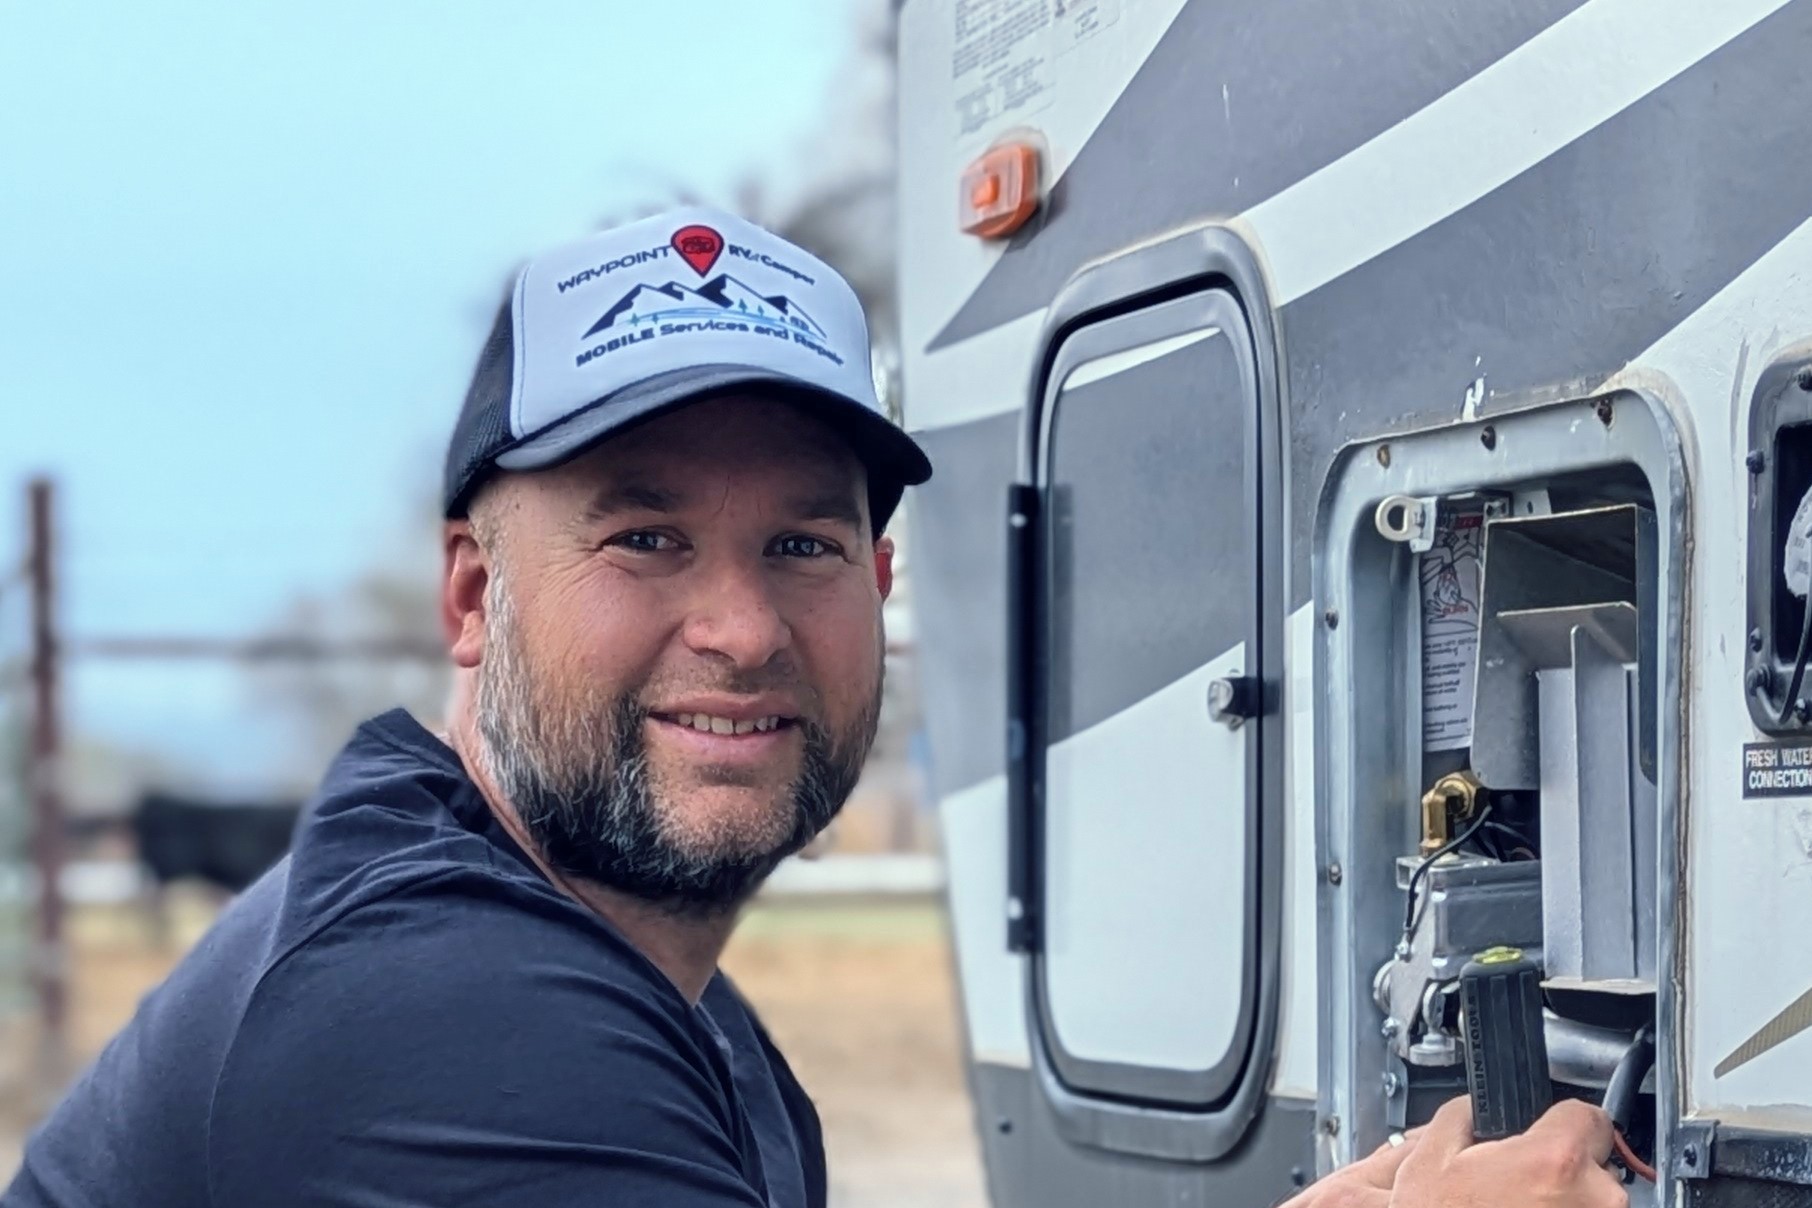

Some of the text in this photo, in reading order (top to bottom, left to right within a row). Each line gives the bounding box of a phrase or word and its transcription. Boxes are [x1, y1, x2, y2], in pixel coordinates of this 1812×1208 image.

[557, 245, 671, 294] WAYPOINT
[728, 244, 752, 258] RV
[576, 327, 655, 367] MOBILE
[660, 320, 750, 337] Services
[754, 325, 789, 341] and
[1745, 749, 1778, 768] FRESH
[1474, 1060, 1489, 1114] KLEIN
